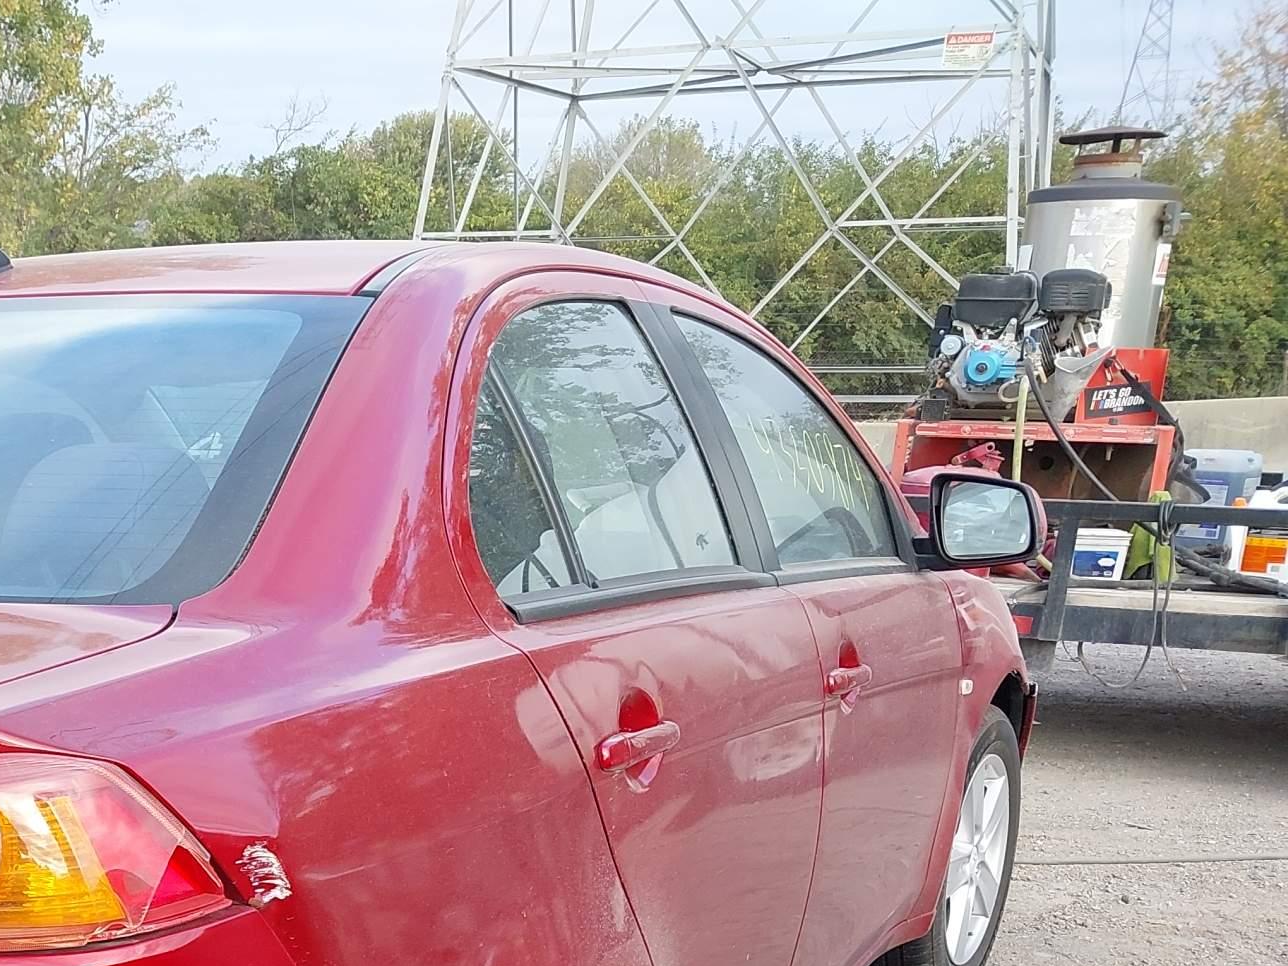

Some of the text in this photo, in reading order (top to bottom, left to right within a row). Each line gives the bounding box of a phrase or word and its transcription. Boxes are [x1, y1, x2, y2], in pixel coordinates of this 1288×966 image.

[957, 34, 992, 44] DANGER
[1092, 386, 1133, 401] LET'S GO
[746, 409, 870, 511] 43505874
